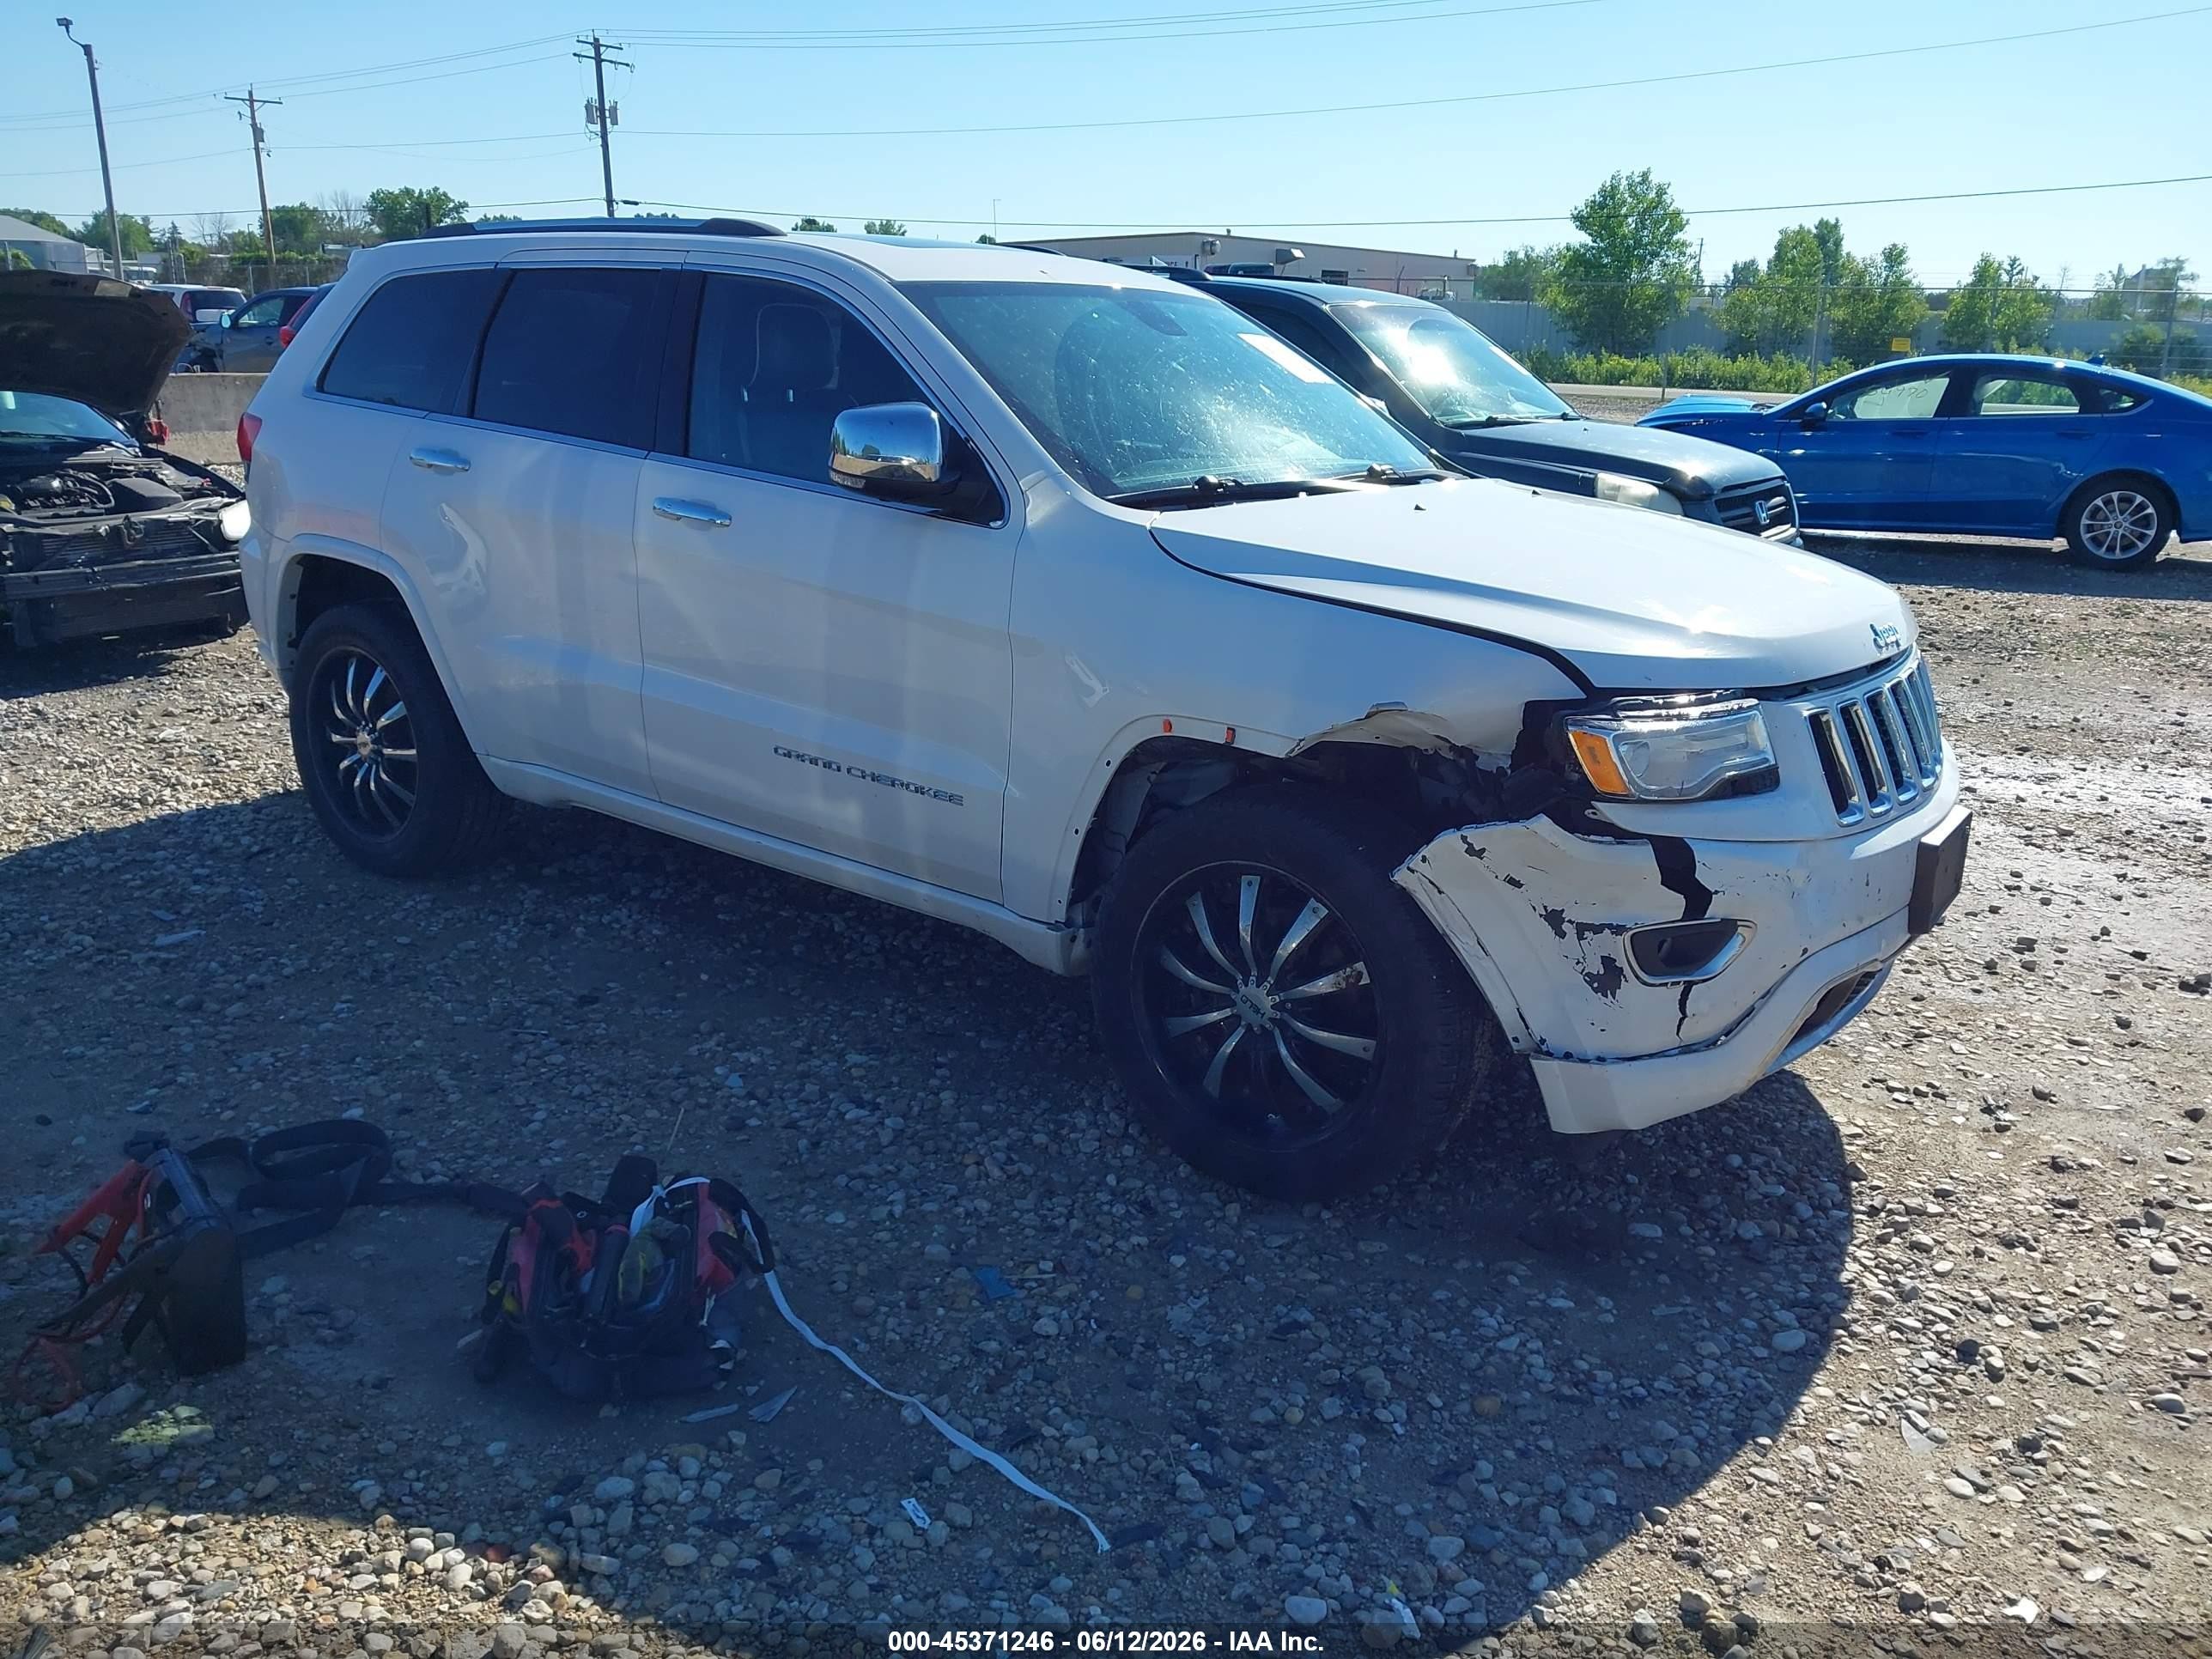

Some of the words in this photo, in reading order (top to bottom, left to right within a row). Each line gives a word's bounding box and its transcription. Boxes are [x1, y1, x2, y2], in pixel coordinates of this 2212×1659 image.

[1869, 623, 1901, 650] Jeep
[772, 744, 842, 773] GRAND
[846, 764, 964, 807] CHEROKEE
